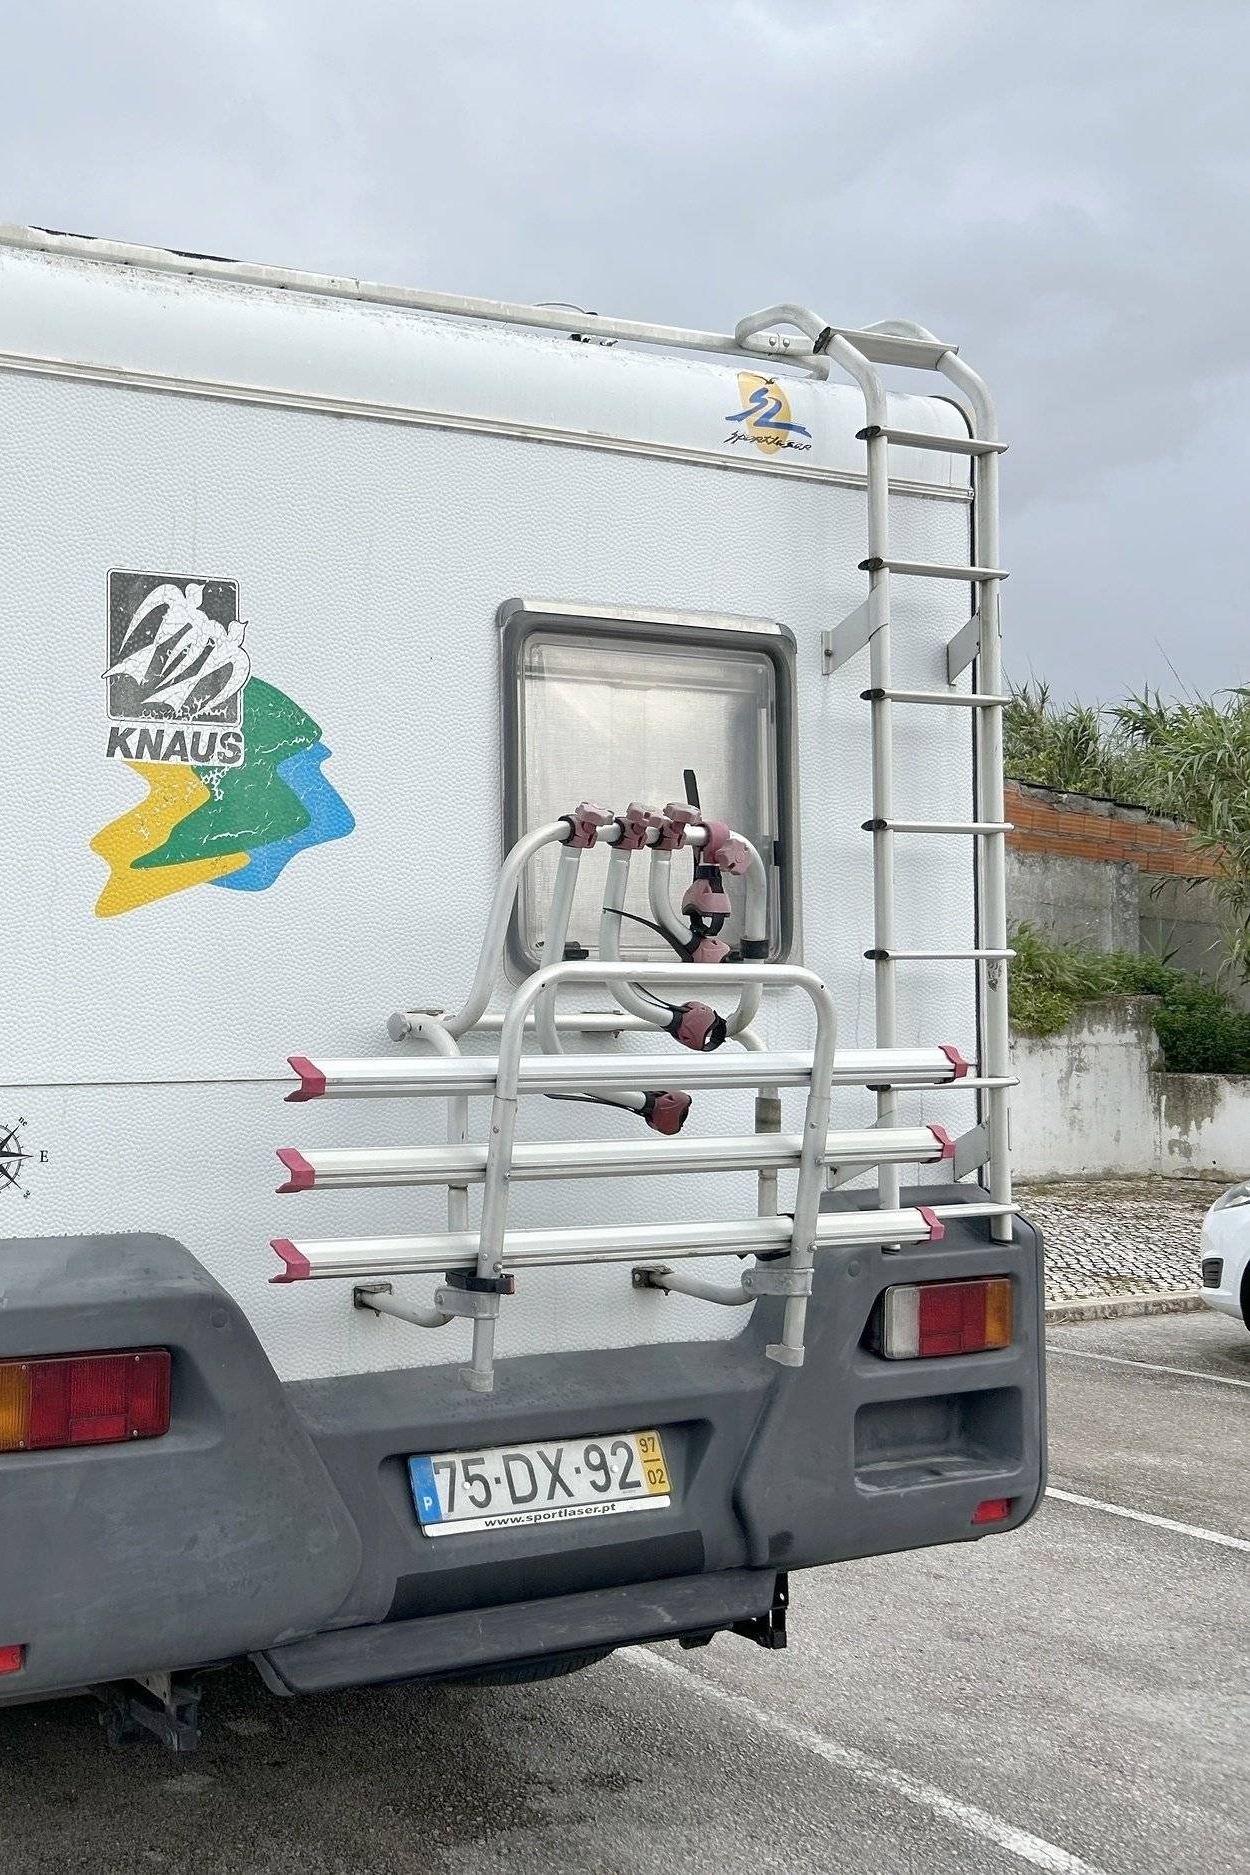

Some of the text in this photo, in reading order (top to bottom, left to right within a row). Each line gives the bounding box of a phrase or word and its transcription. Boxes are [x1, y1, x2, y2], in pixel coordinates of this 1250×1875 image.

[106, 727, 243, 764] KNAUS
[40, 1150, 49, 1163] E
[639, 1437, 656, 1454] 97
[647, 1468, 666, 1486] 02
[423, 1496, 433, 1512] P
[484, 1503, 616, 1528] www.sportlaser.pt
